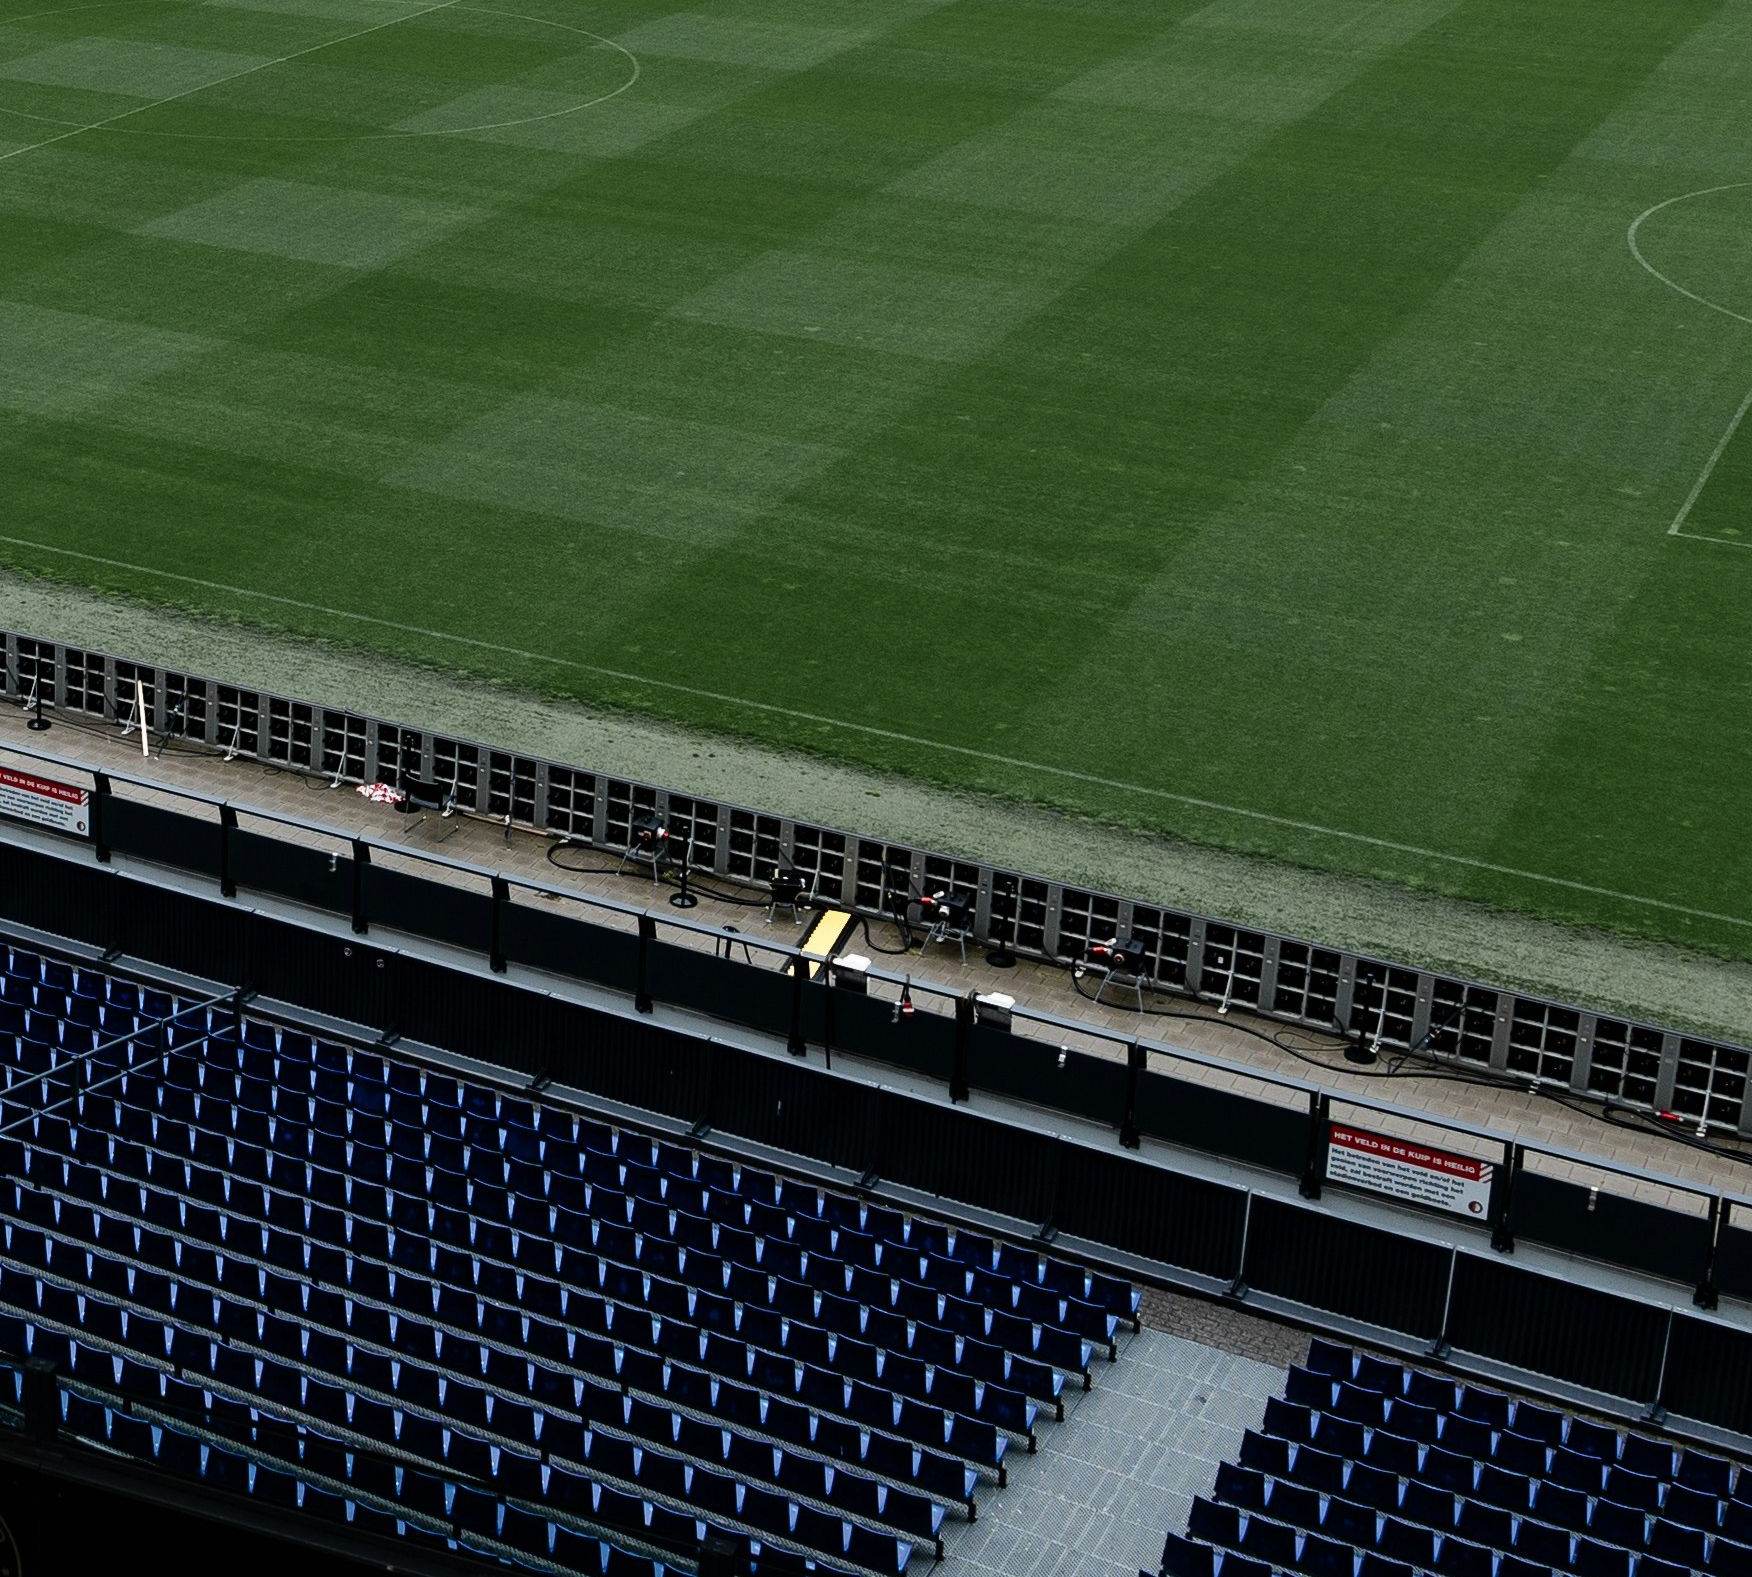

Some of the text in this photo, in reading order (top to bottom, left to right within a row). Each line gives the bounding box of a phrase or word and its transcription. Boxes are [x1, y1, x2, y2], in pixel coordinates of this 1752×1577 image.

[1334, 1131, 1353, 1142] HET
[1354, 1136, 1378, 1148] VELD
[1381, 1143, 1391, 1152] IN
[1392, 1147, 1406, 1156] DE
[1407, 1150, 1431, 1162] KUIP
[1432, 1156, 1442, 1165] IS
